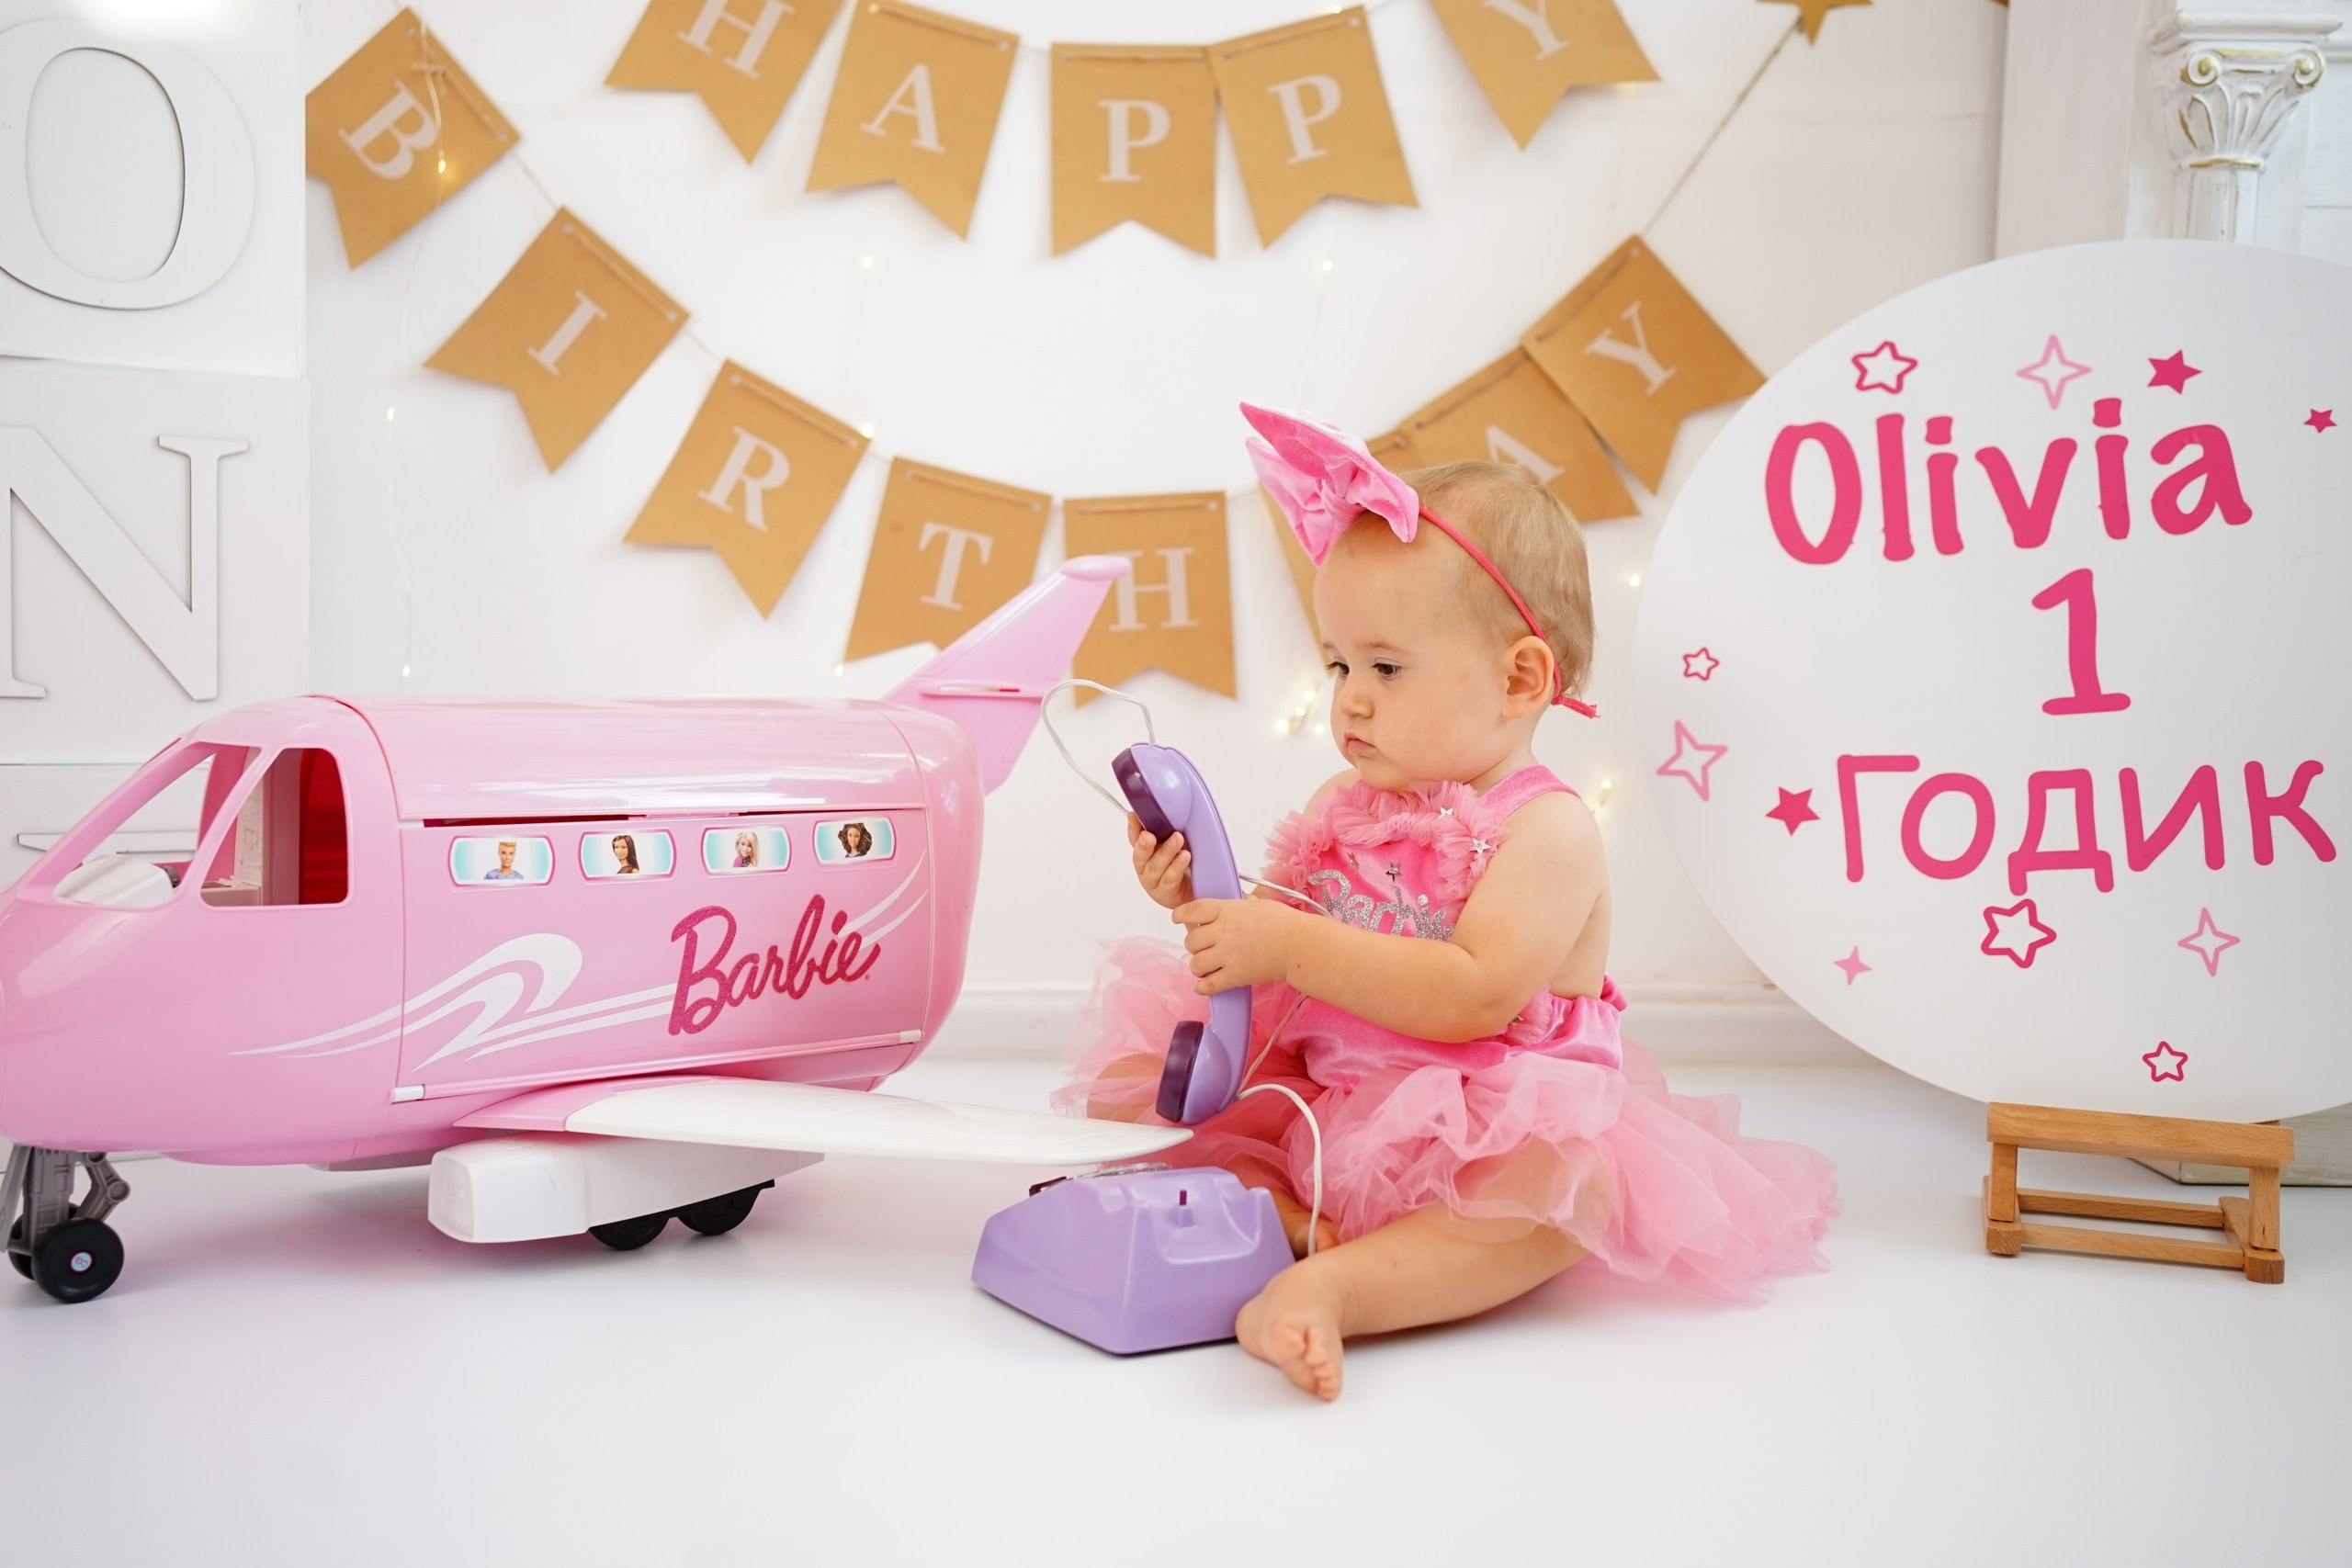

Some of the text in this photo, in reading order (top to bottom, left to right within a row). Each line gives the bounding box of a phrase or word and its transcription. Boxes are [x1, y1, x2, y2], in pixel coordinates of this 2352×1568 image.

[1765, 397, 2253, 564] Olivia
[2031, 568, 2132, 715] 1
[1837, 754, 2337, 897] Годик
[668, 894, 881, 1036] Barbie
